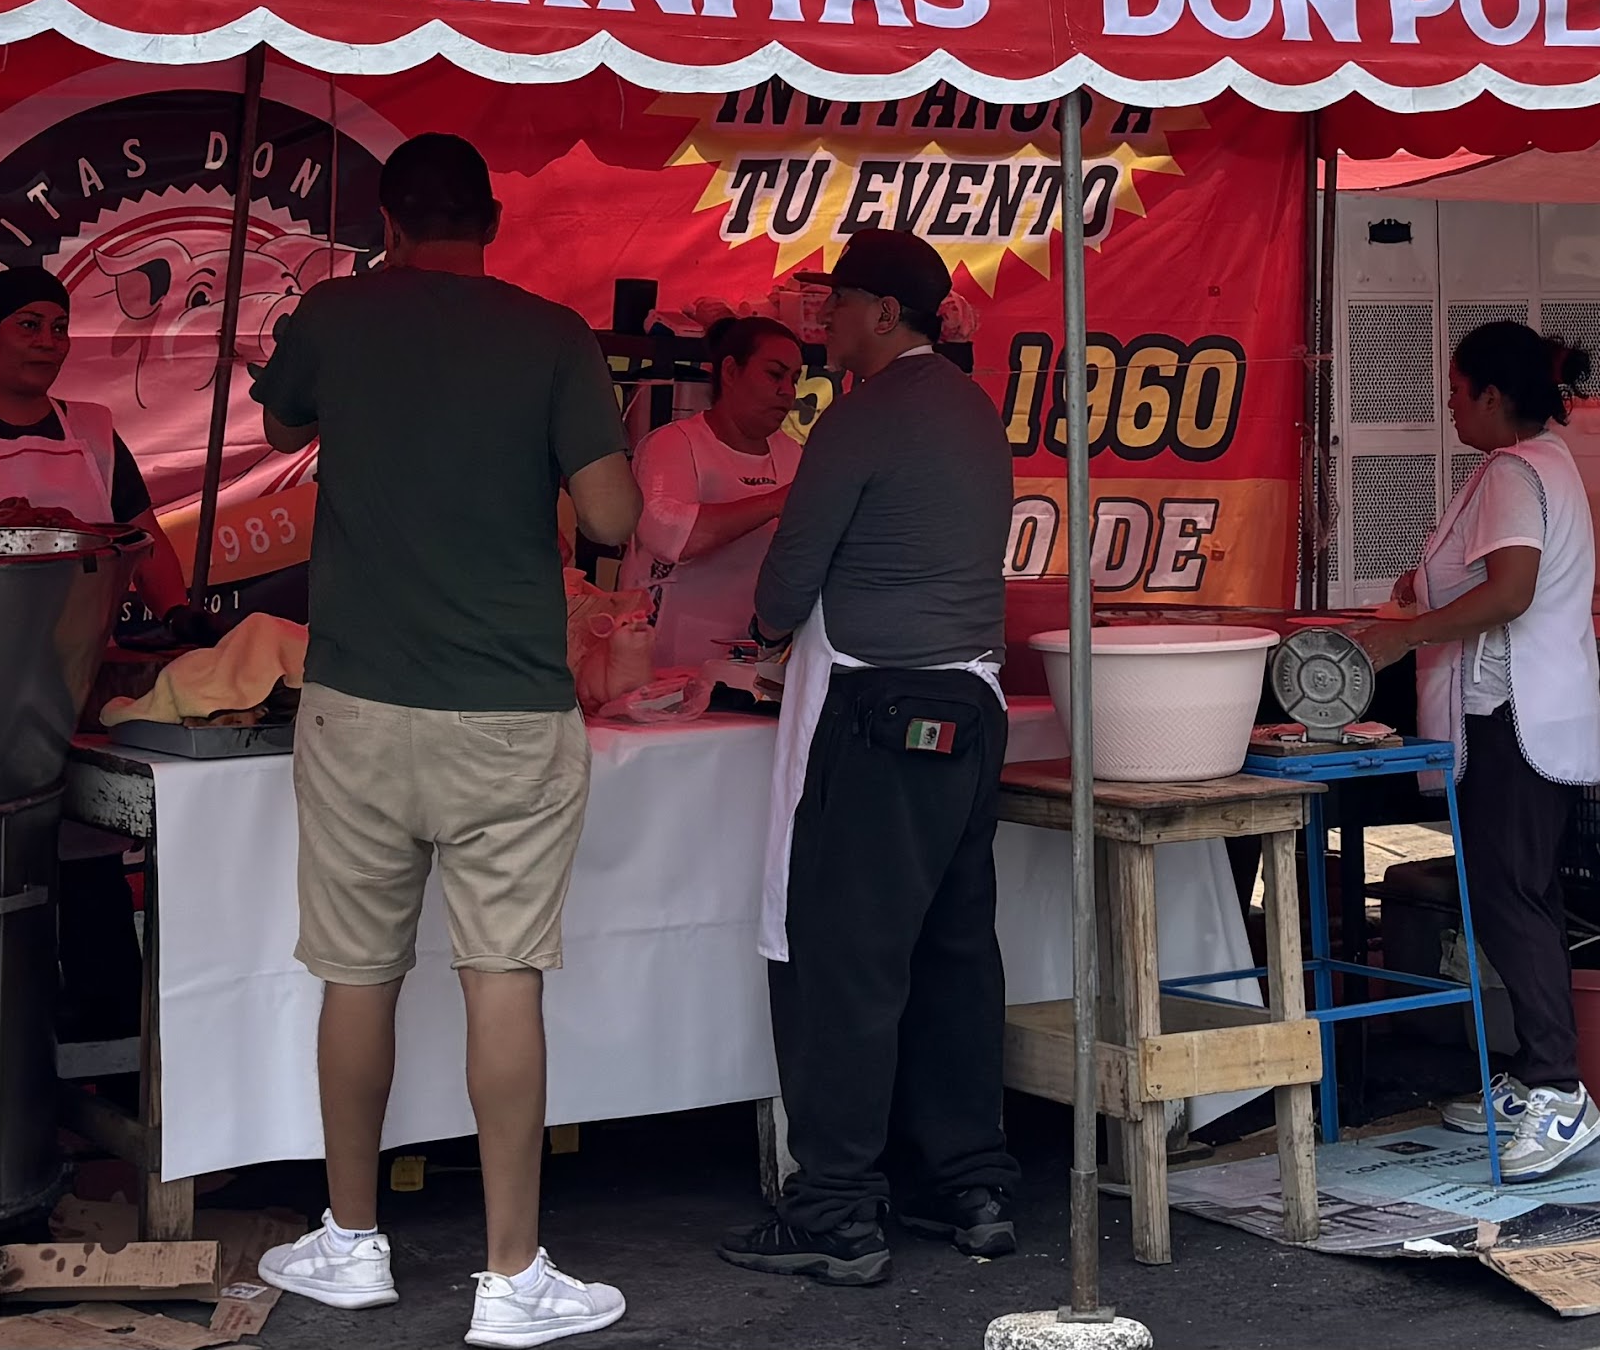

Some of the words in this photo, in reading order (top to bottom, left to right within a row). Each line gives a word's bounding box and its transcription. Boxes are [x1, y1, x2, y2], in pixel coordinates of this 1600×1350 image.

[204, 131, 323, 199] DON
[726, 158, 831, 236] TU
[837, 159, 1121, 238] EVENTO
[1005, 344, 1240, 449] 1960
[217, 507, 297, 563] 983
[1090, 500, 1219, 589] DE
